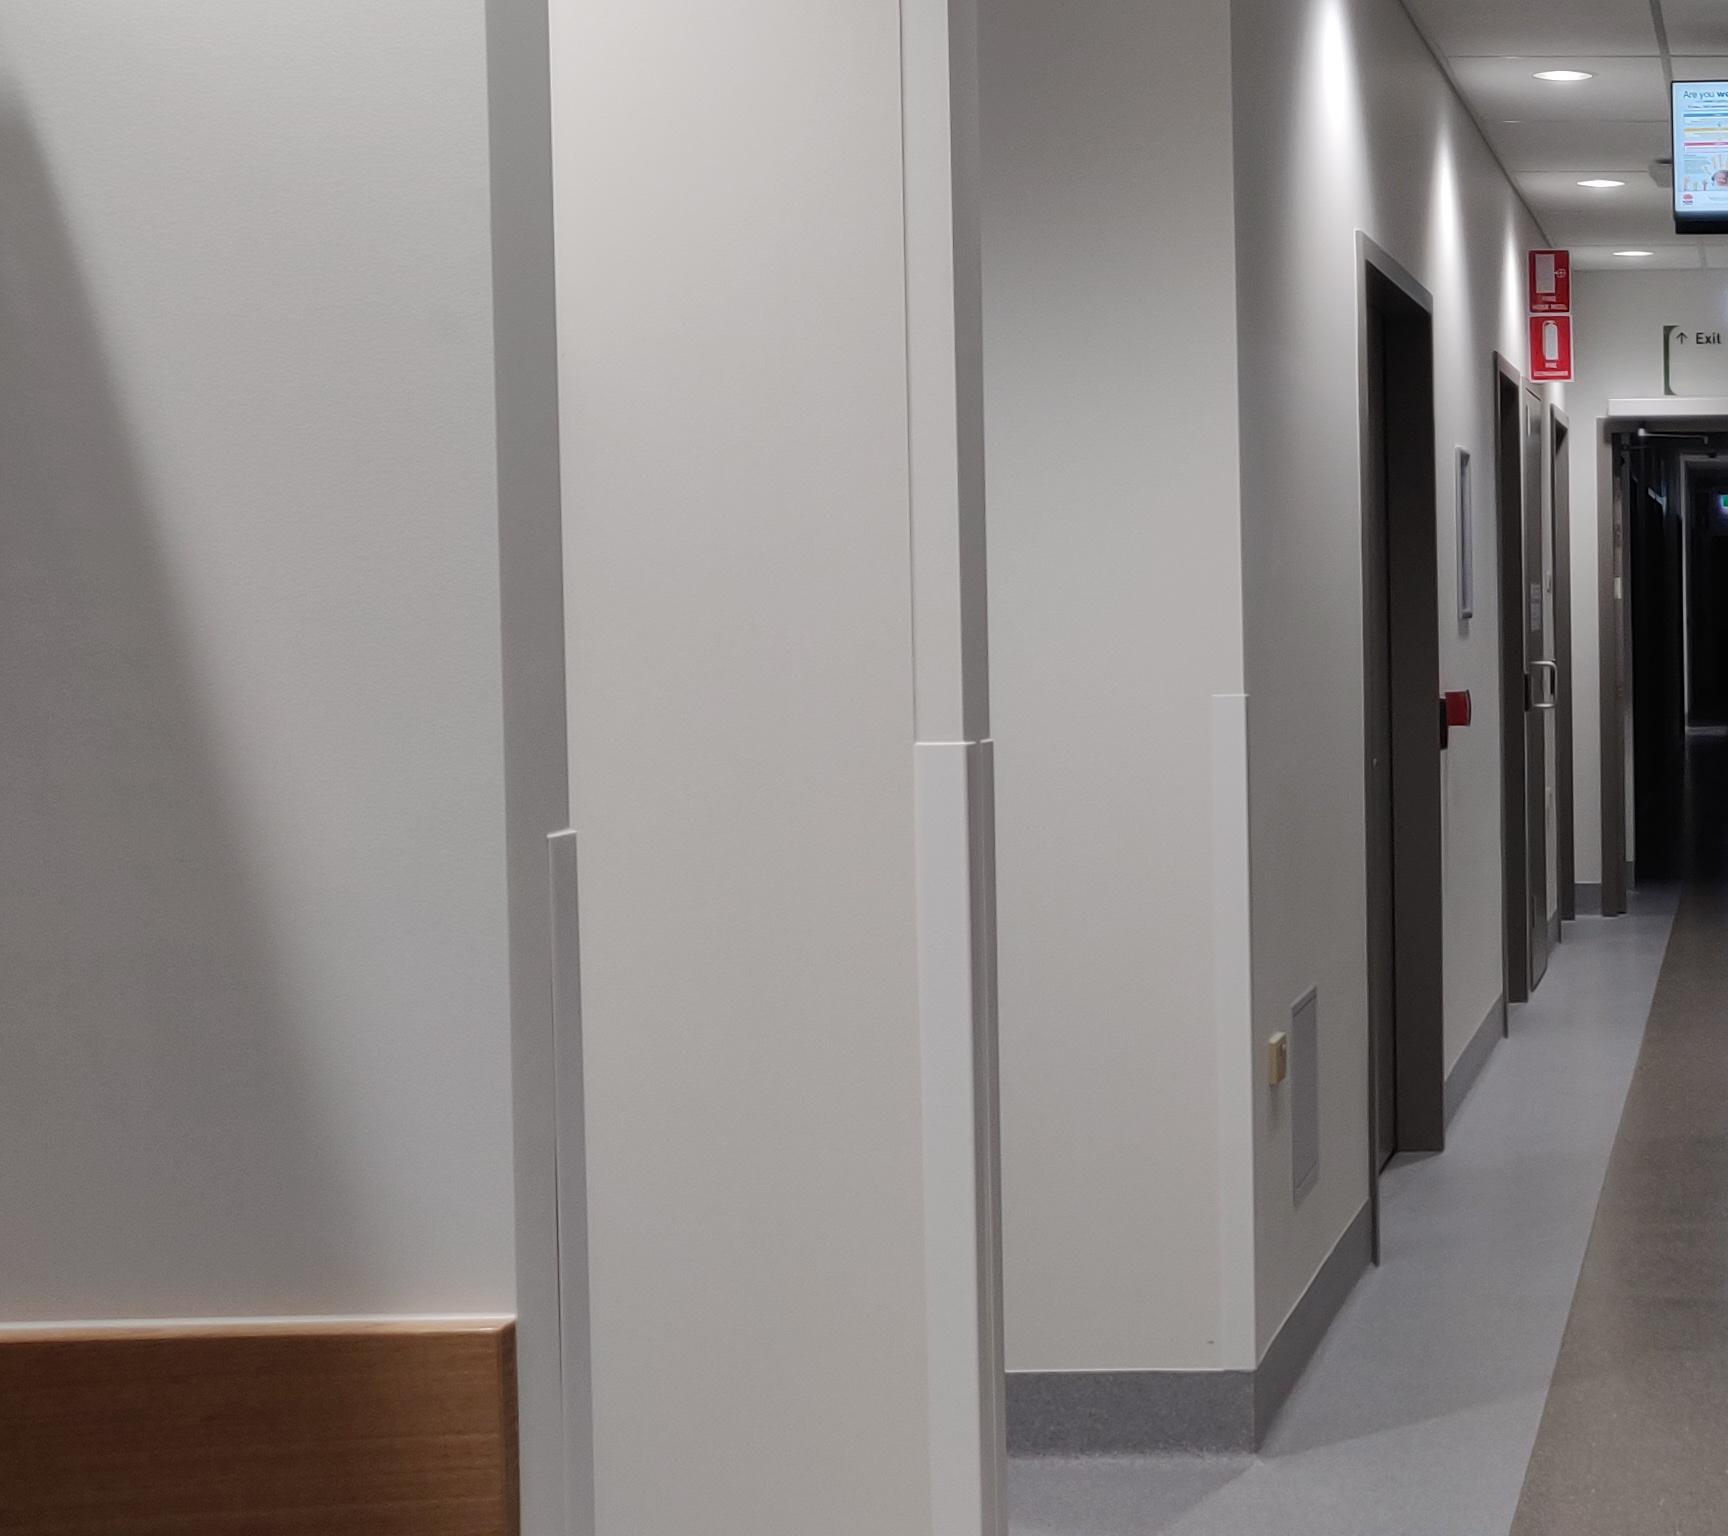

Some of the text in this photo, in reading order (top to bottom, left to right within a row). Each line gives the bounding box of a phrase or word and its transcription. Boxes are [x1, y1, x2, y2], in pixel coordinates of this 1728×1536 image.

[1683, 90, 1698, 98] Are
[1698, 91, 1714, 99] you
[1696, 331, 1721, 345] Exit
